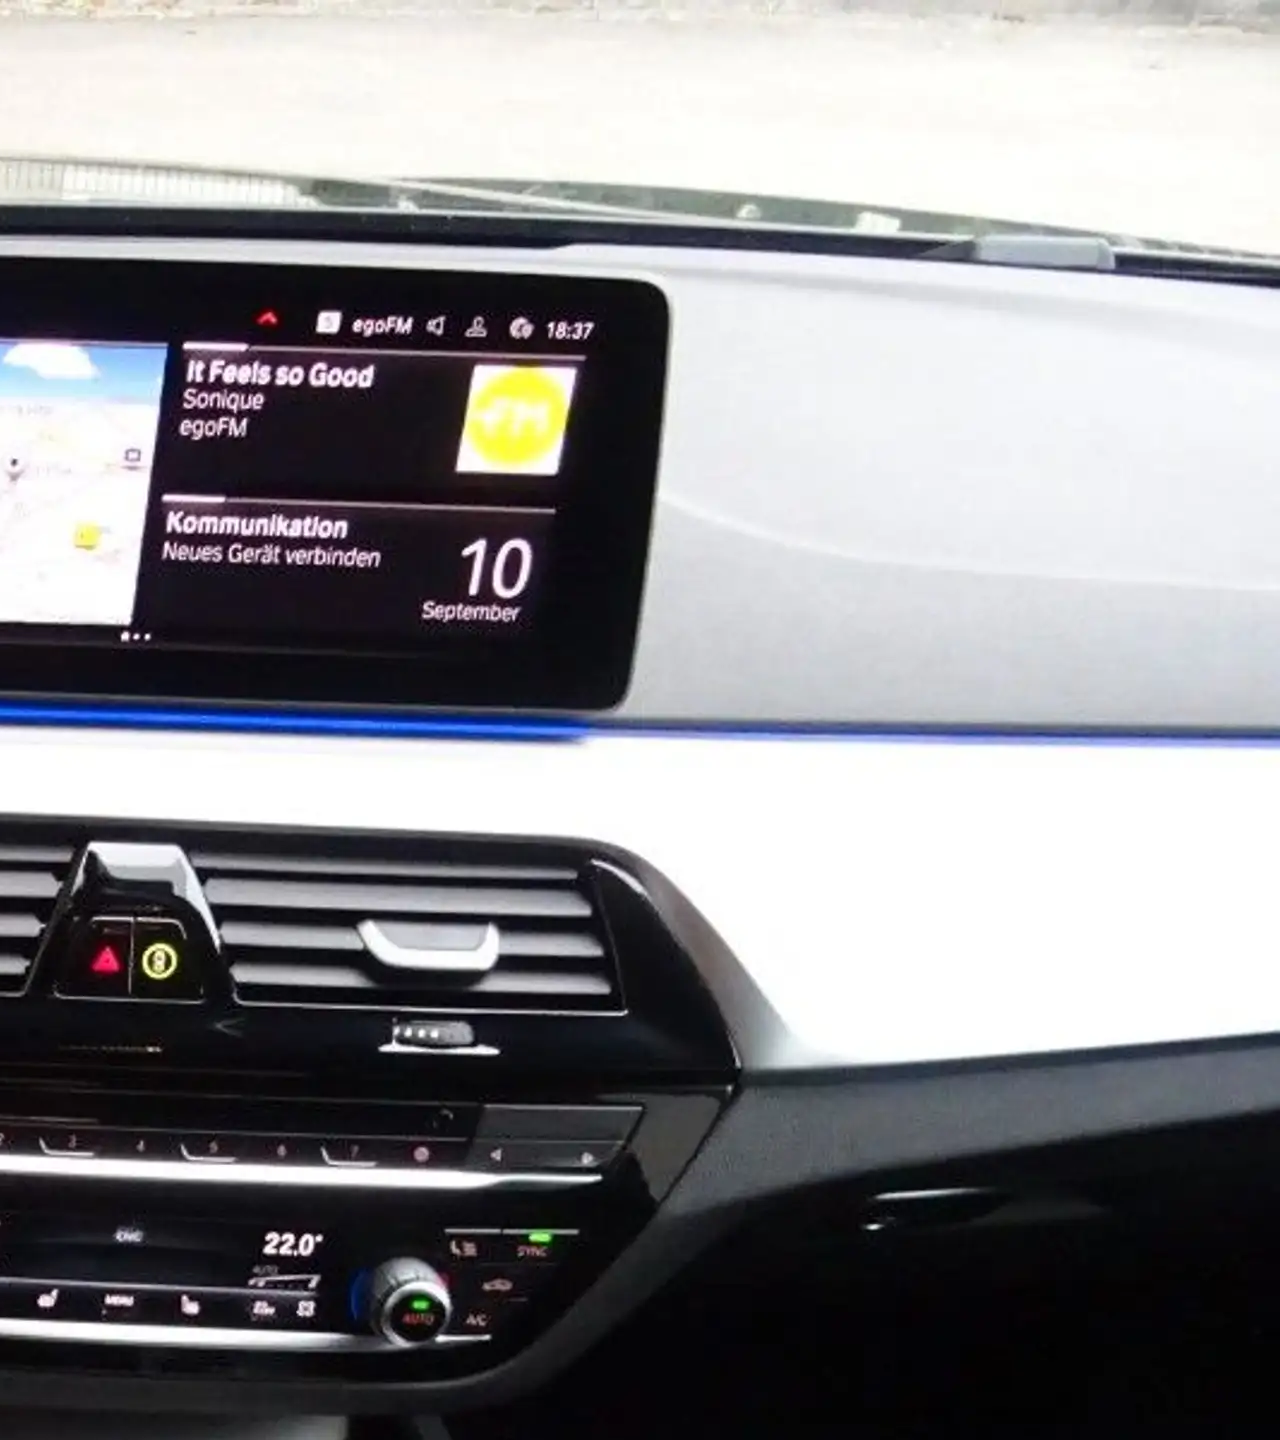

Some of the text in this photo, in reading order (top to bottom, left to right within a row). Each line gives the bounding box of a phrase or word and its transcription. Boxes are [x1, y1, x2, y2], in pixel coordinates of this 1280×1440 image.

[352, 316, 414, 338] egoFM
[547, 321, 595, 340] 18:37
[186, 360, 375, 388] It Feels so Good
[182, 389, 264, 411] Sonique
[179, 418, 248, 440] egoFM
[166, 511, 348, 540] Kommunikation
[162, 541, 381, 568] Neues Gerät verbinden
[459, 538, 533, 600] 10
[422, 601, 521, 624] September
[402, 1312, 435, 1325] AUTO
